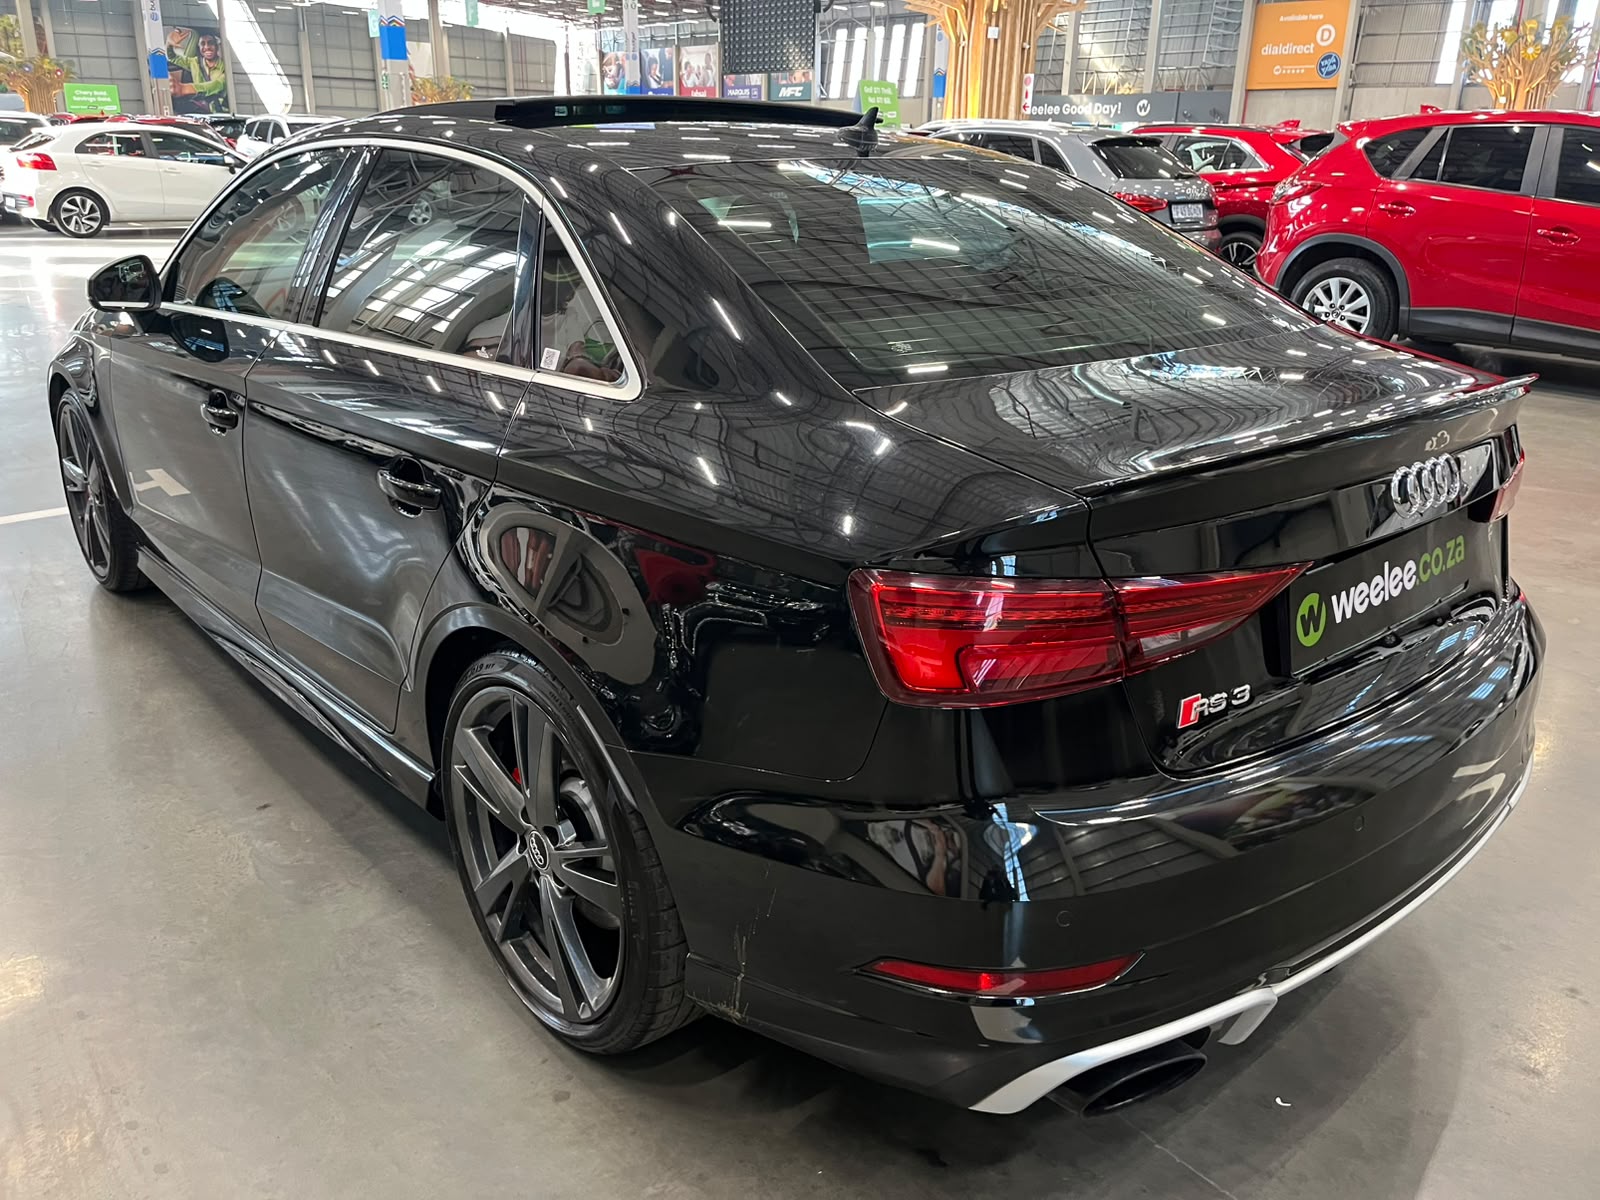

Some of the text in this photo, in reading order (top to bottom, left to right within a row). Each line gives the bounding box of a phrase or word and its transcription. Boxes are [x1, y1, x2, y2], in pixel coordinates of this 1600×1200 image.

[1261, 42, 1315, 56] dialdirect
[778, 86, 804, 98] MFC
[1031, 102, 1122, 118] eelee Good Day!
[1331, 535, 1465, 624] weelee.co.za
[1187, 684, 1251, 723] RS 3
